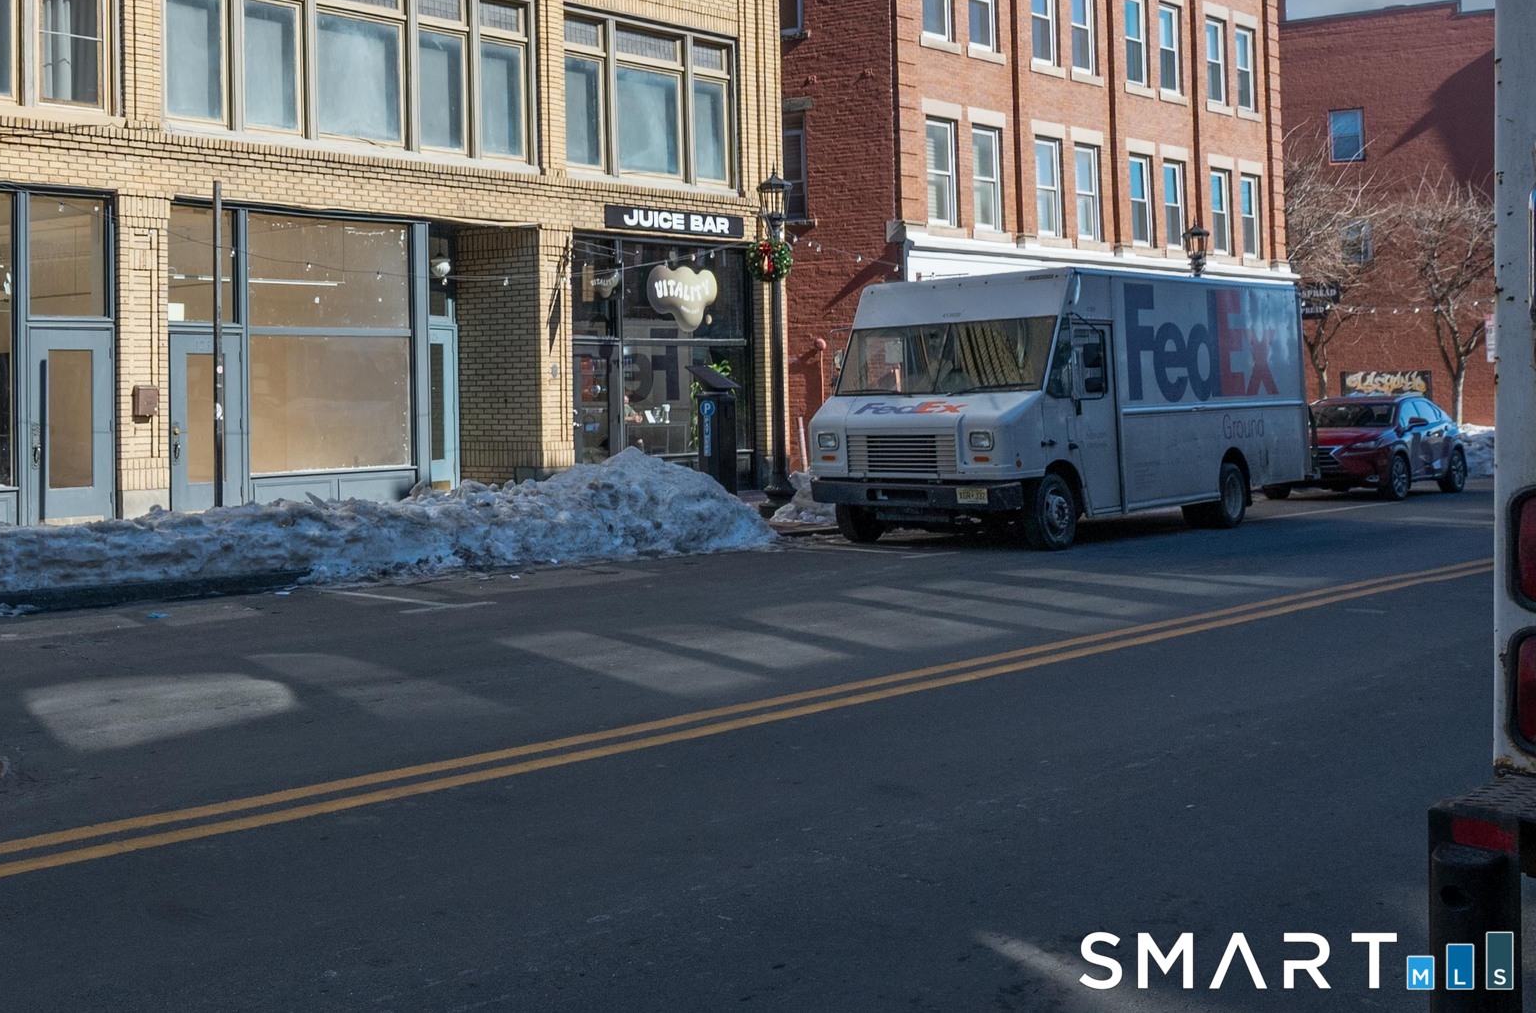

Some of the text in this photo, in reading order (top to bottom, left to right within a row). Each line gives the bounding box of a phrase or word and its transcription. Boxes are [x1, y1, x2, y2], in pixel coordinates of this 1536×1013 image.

[623, 209, 730, 234] JUICE BAR
[654, 279, 711, 302] VITALITY
[1123, 283, 1280, 403] FedEx
[854, 401, 969, 415] FedEx
[1222, 413, 1265, 440] Ground
